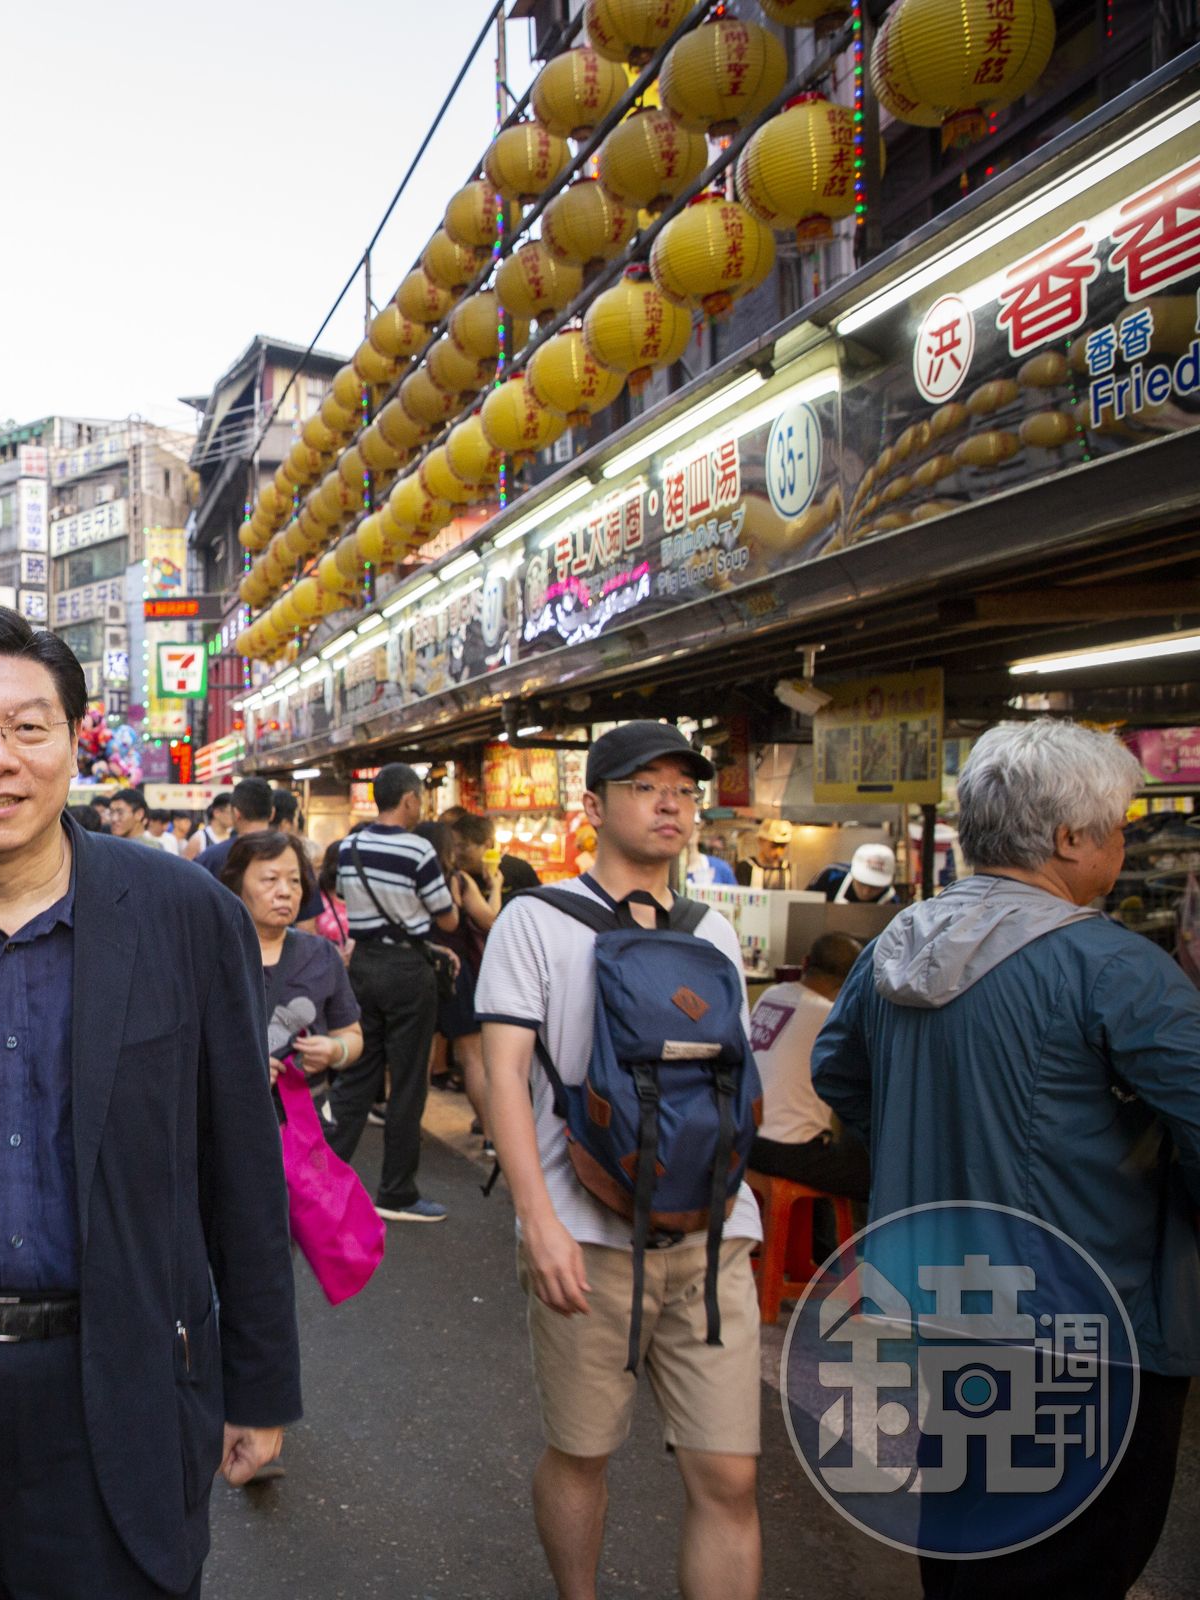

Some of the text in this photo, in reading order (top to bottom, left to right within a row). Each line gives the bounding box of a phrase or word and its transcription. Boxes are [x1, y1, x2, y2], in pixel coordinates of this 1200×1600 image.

[926, 318, 962, 387] 洪
[1090, 343, 1200, 426] Fried
[776, 416, 812, 500] 35-1
[717, 547, 749, 575] Soup
